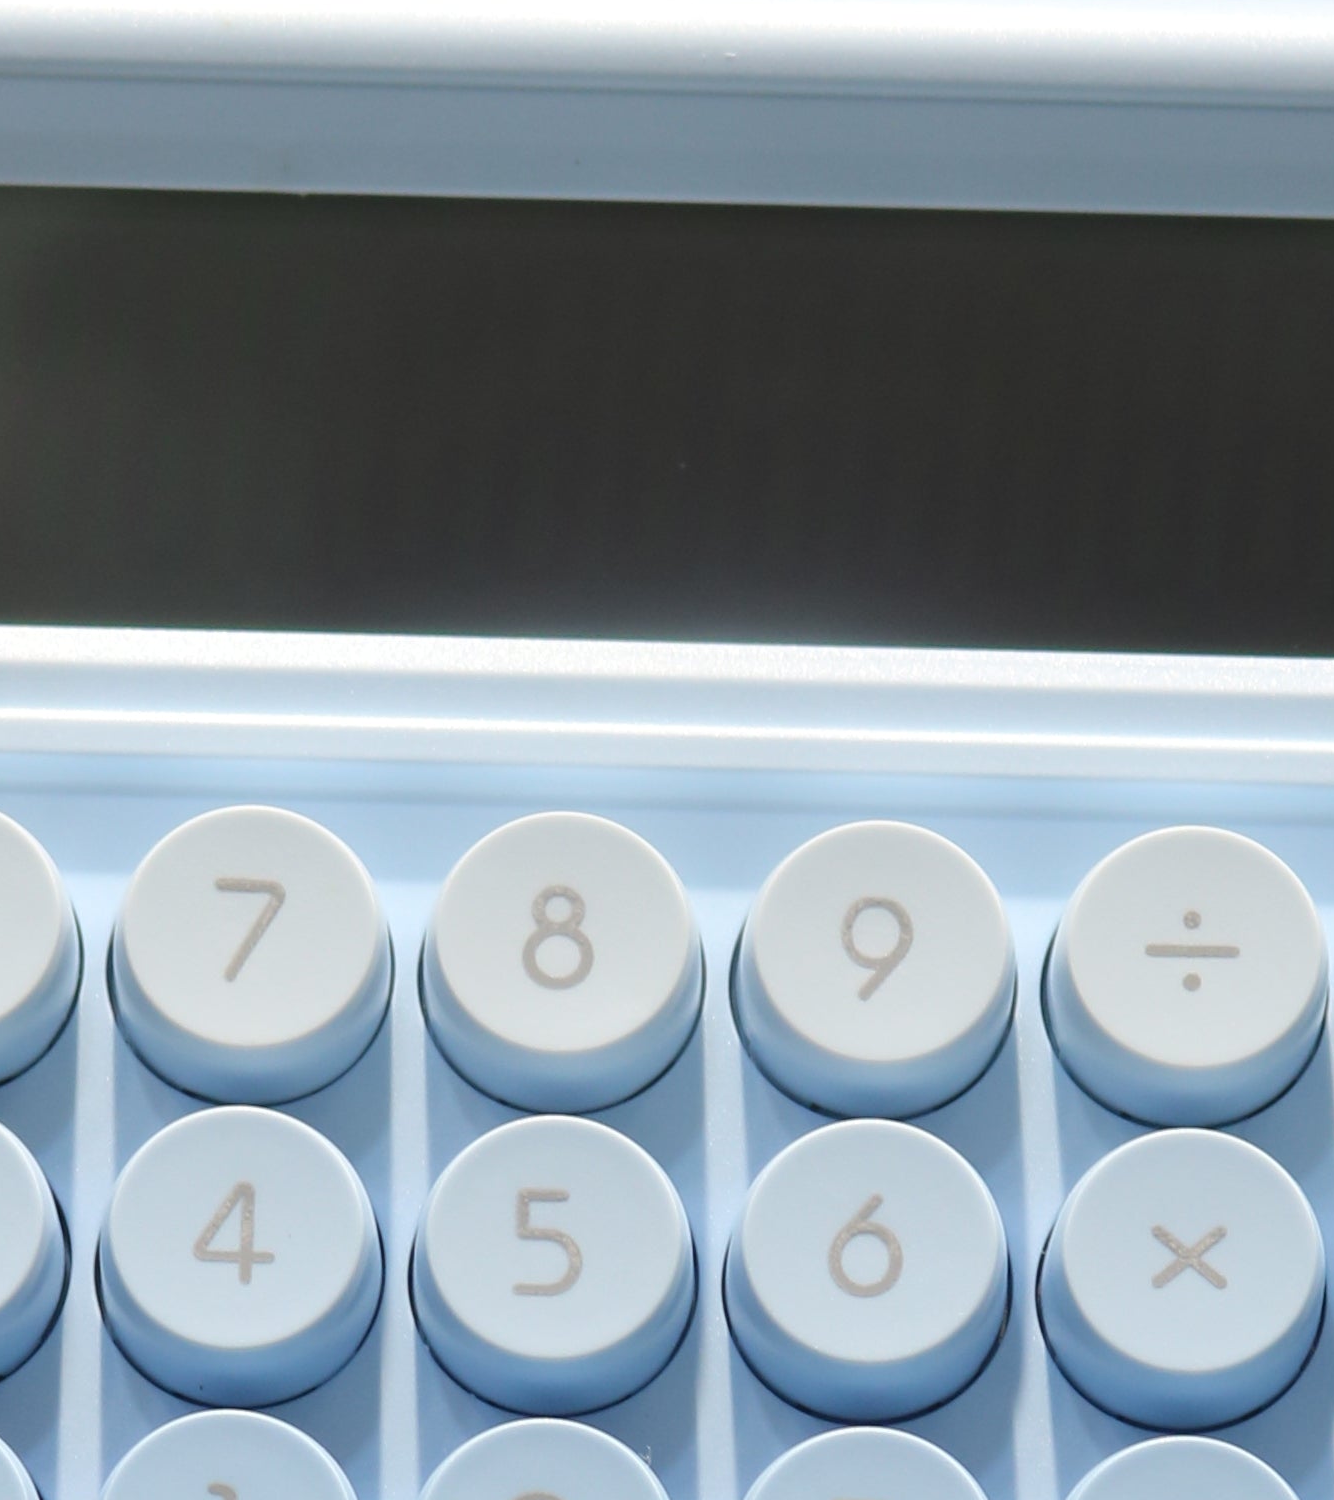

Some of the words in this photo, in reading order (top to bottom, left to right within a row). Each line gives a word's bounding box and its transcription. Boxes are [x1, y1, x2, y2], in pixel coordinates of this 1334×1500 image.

[212, 875, 287, 982] 7
[520, 883, 595, 991] 8
[839, 895, 915, 1002] 9
[191, 1180, 276, 1285] 4
[512, 1186, 584, 1297] 5
[826, 1192, 905, 1298] 6
